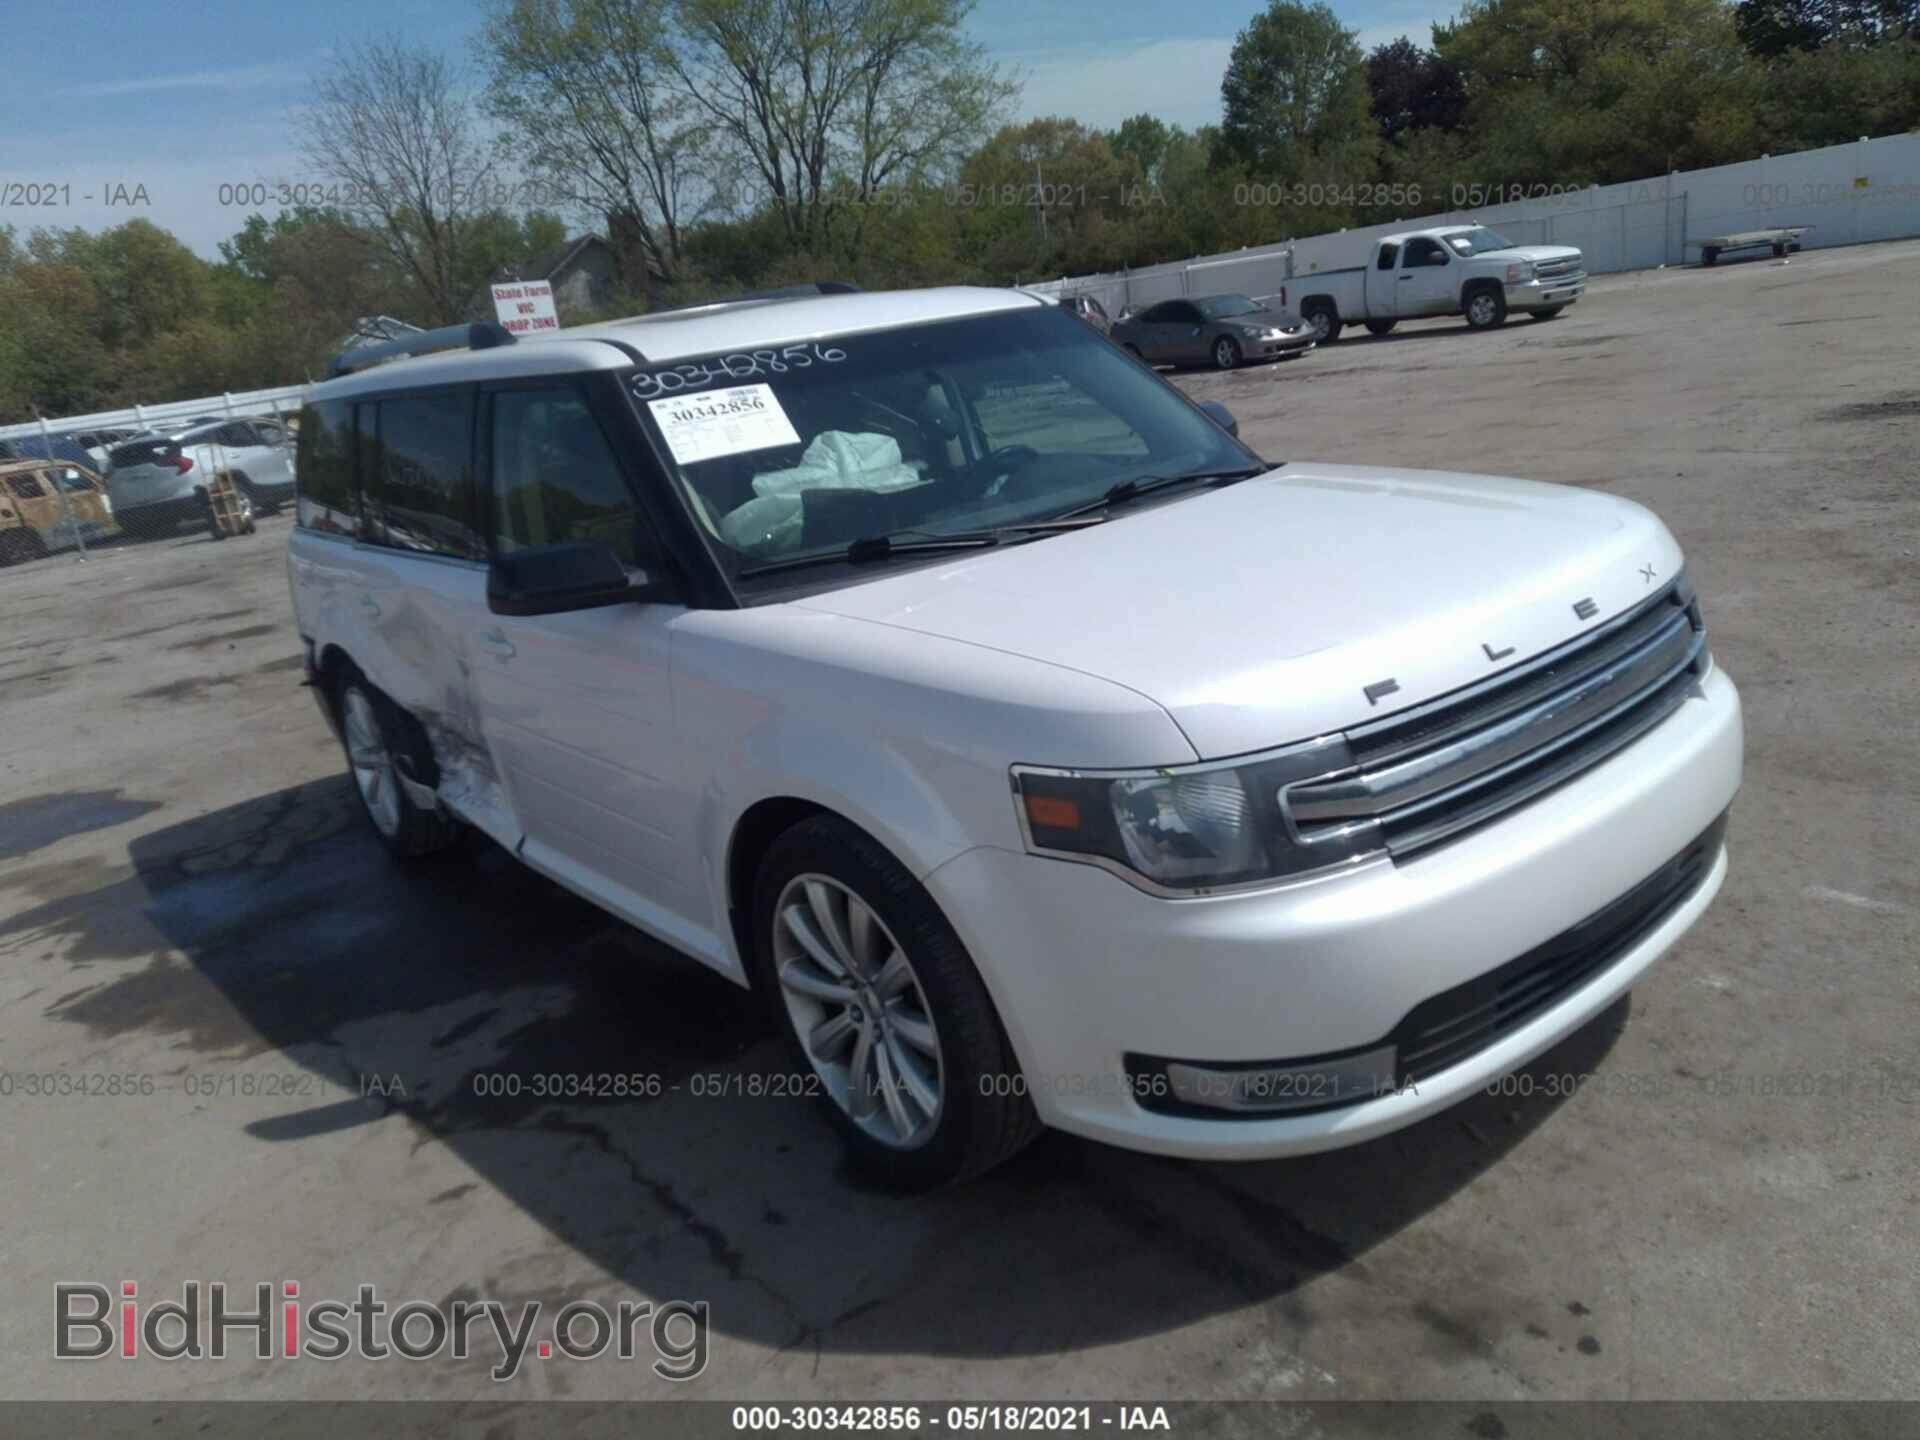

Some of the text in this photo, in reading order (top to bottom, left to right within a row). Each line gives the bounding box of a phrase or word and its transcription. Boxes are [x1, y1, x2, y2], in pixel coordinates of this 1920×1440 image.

[495, 287, 551, 300] State Farm
[532, 316, 556, 329] ZONE
[632, 344, 847, 398] 30342856
[670, 396, 765, 424] 30342856
